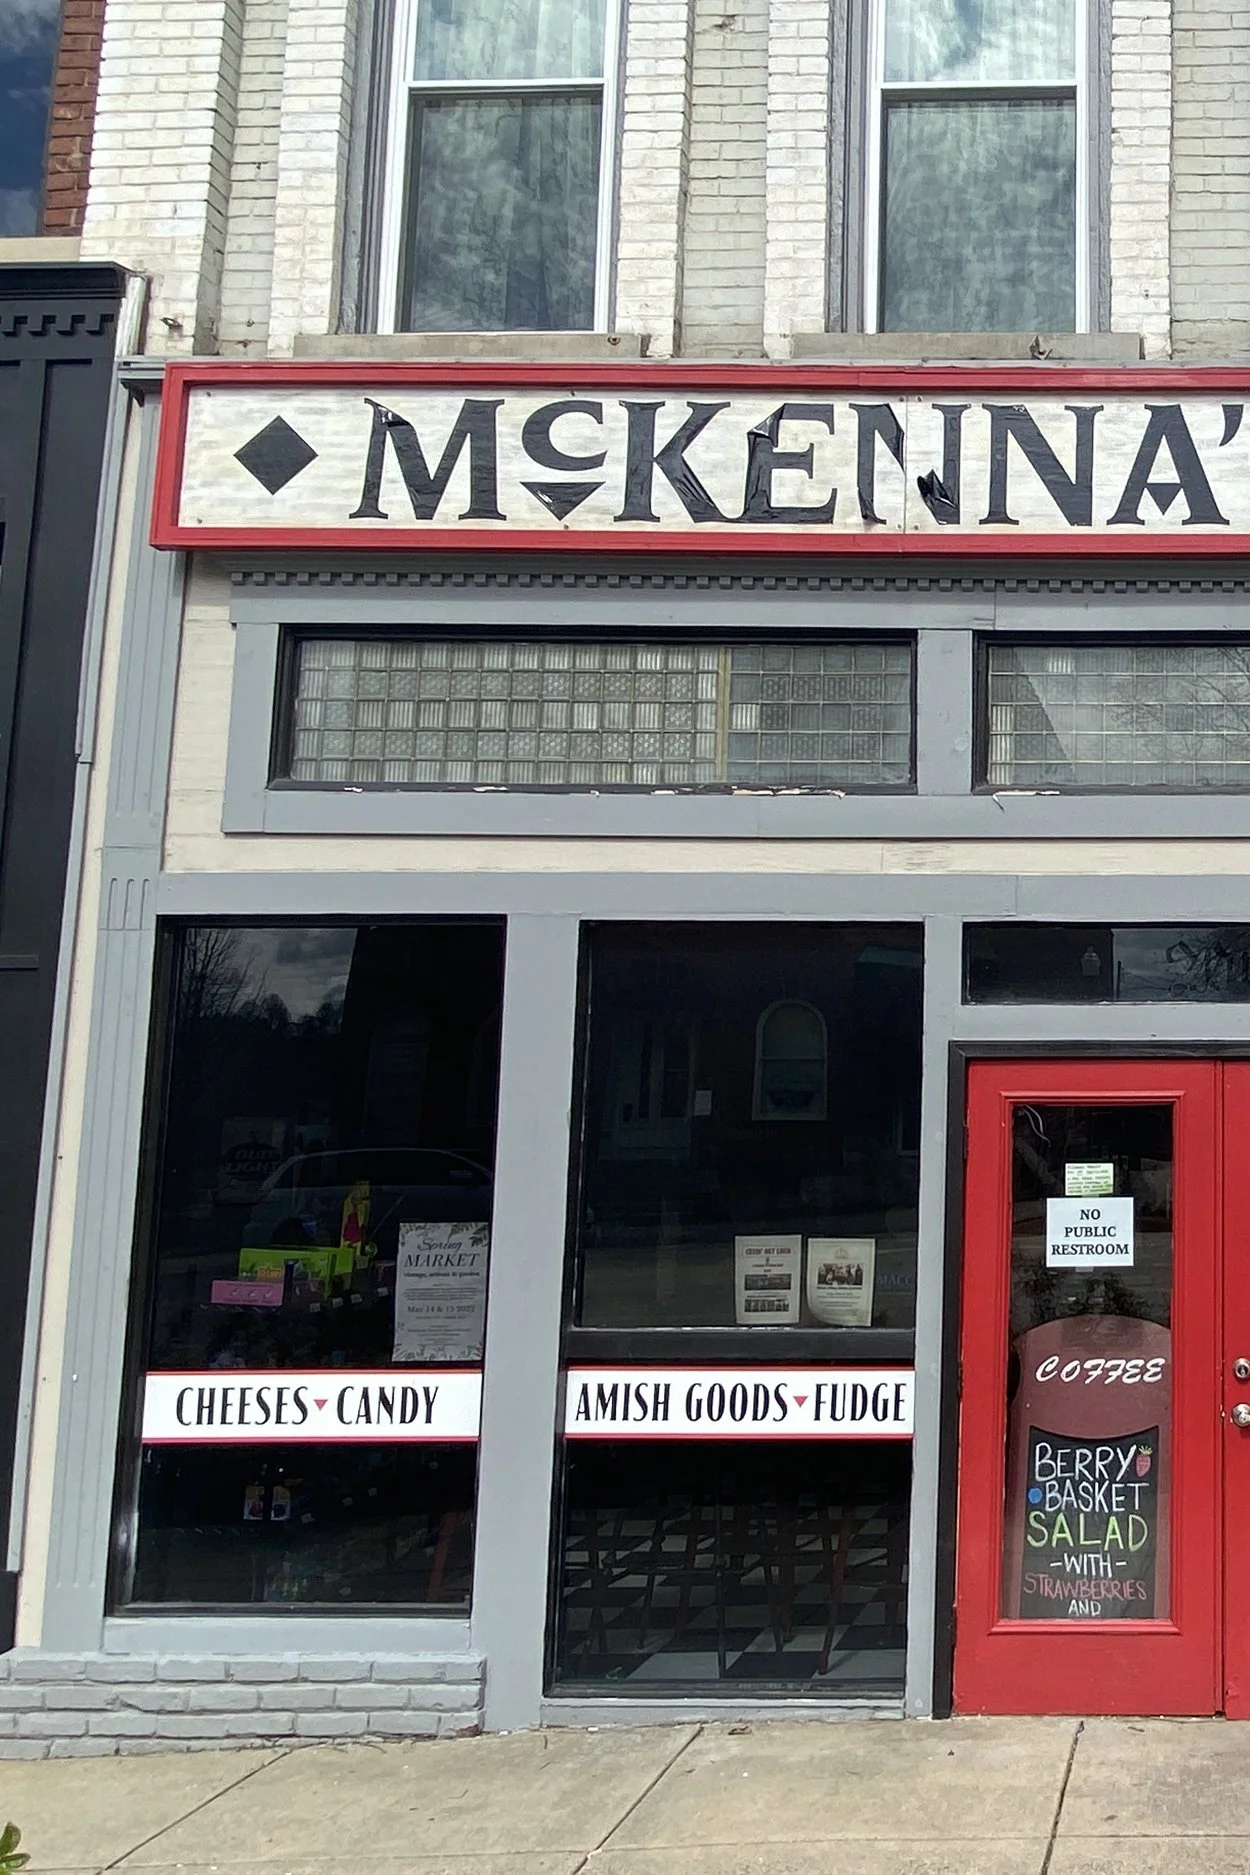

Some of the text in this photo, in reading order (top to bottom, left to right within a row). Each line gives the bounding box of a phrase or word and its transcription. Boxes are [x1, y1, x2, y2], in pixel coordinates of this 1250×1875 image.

[1079, 1208, 1101, 1221] NO
[417, 1237, 462, 1254] Spring
[1064, 1226, 1117, 1238] PUBLIC
[404, 1253, 480, 1268] MARKET
[1051, 1243, 1130, 1256] RESTROOM
[1035, 1355, 1167, 1385] COFFEE
[176, 1386, 439, 1426] CHEESES CANDY
[575, 1382, 908, 1422] AMISH GOODS FUDGE
[1034, 1442, 1137, 1481] BERRY
[1045, 1480, 1150, 1514] BASKET
[1027, 1510, 1149, 1552] SALAD
[1023, 1572, 1148, 1601] STRAWBERRIES
[1067, 1599, 1101, 1617] AND
